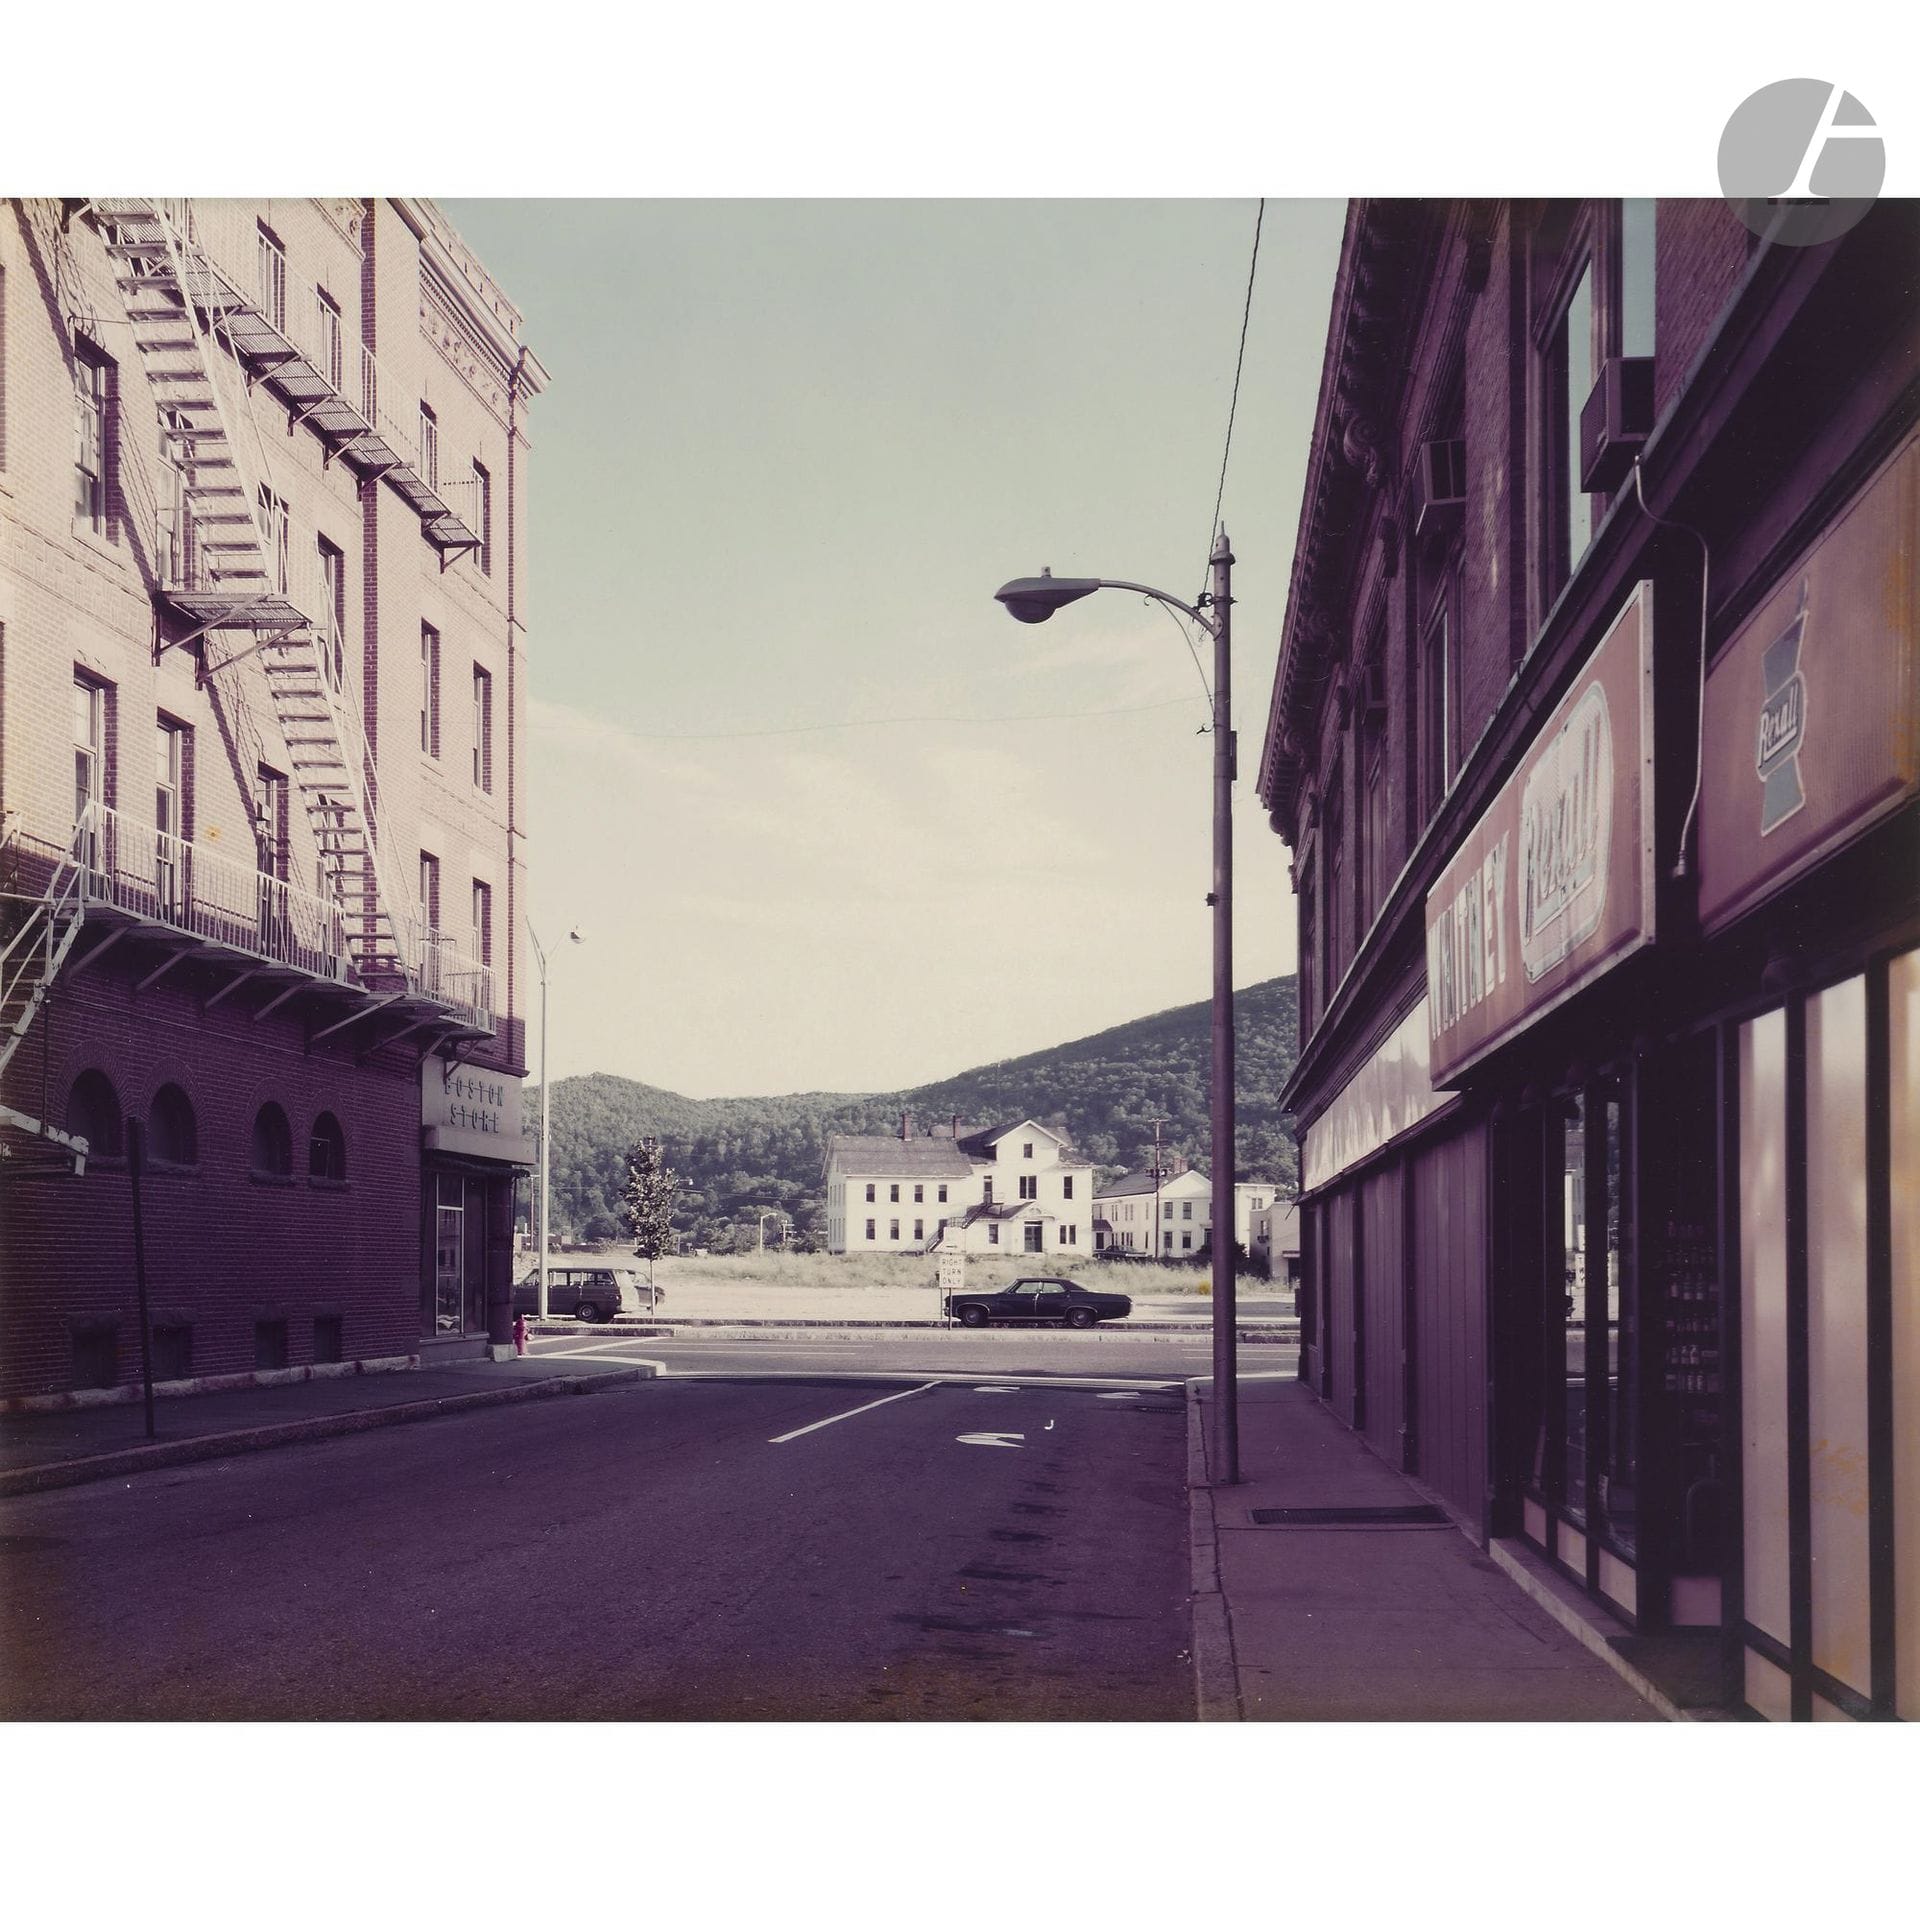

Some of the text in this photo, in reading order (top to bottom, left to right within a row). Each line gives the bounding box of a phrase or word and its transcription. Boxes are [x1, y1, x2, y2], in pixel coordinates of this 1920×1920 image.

[1759, 682, 1798, 768] Rexall
[1427, 710, 1601, 1041] WHITNEY Rexall
[445, 1076, 503, 1107] BOSTON
[450, 1103, 499, 1134] STORE
[941, 1257, 963, 1267] RIGHT
[942, 1267, 962, 1276] TURN
[942, 1276, 962, 1285] ONLY
